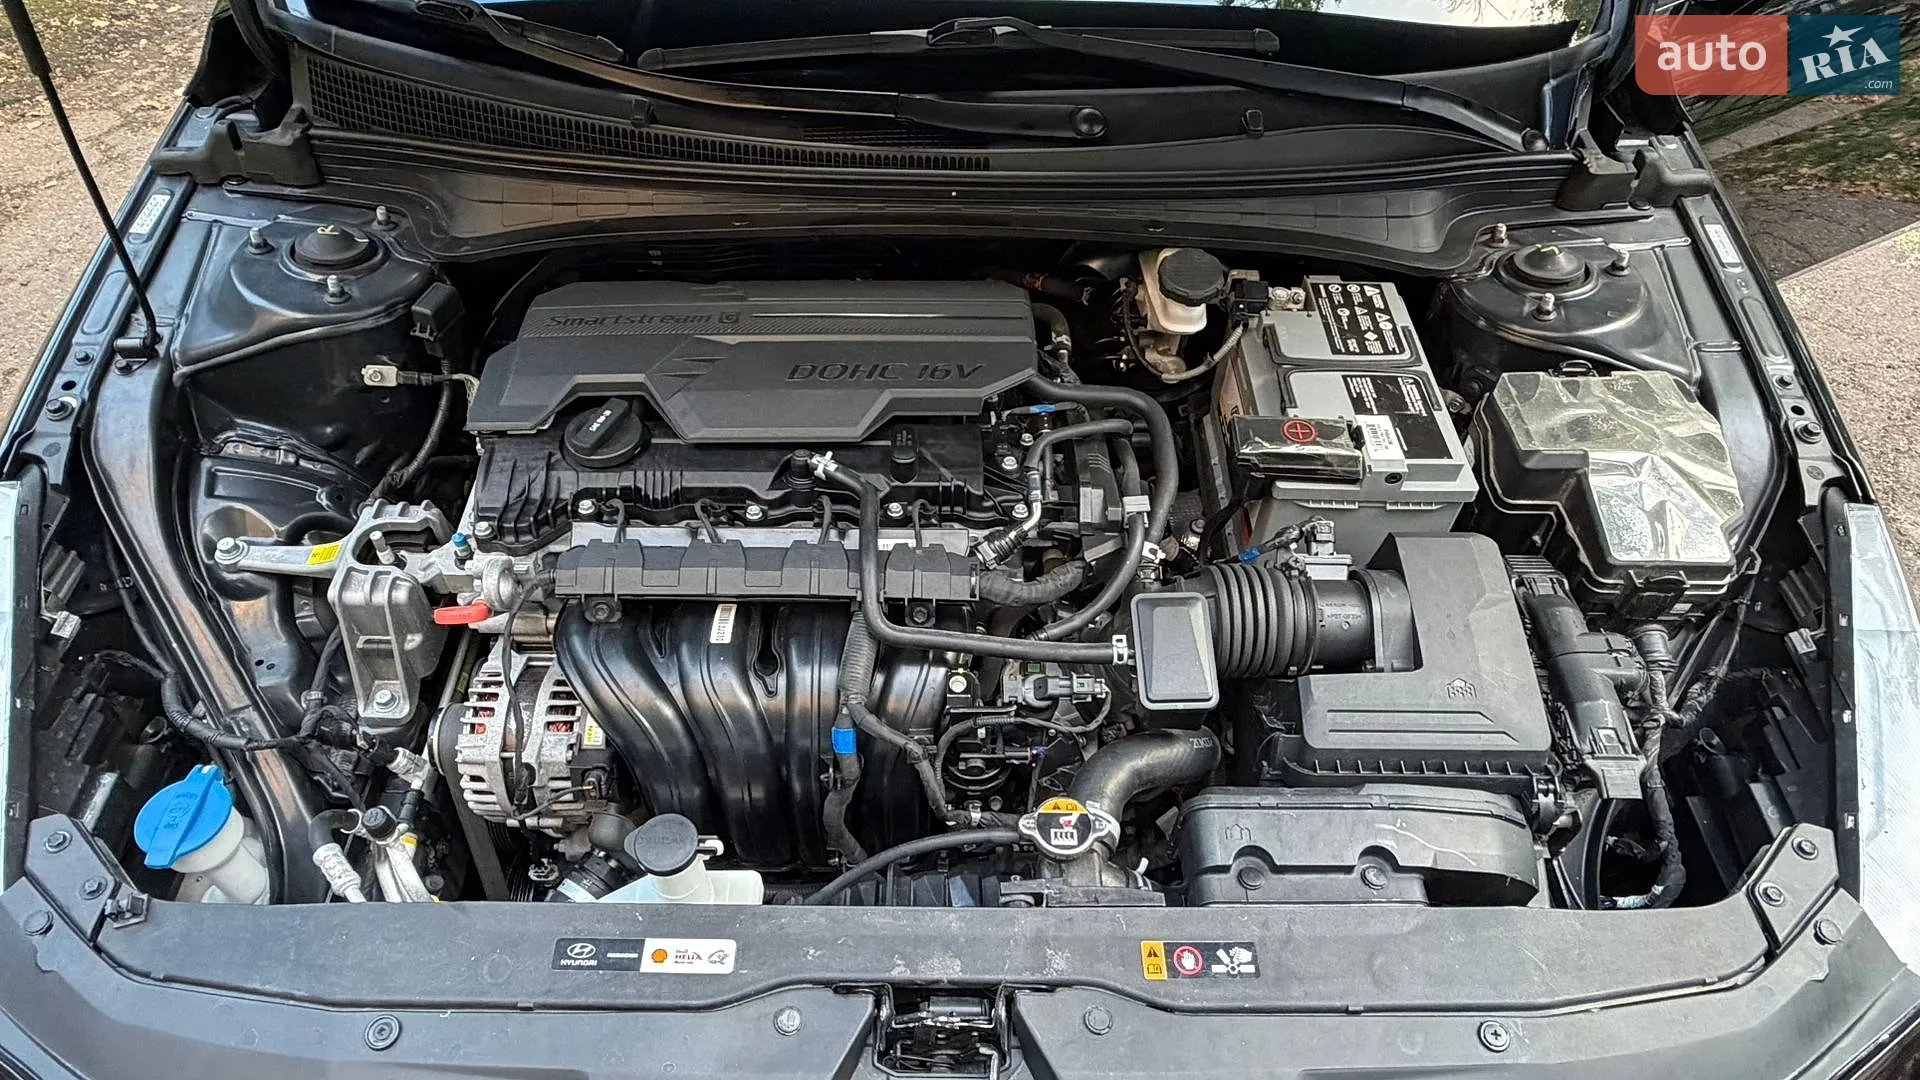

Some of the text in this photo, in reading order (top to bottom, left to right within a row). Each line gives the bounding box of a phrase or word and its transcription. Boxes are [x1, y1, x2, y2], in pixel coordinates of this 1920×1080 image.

[546, 312, 713, 328] Smartstream
[786, 362, 986, 382] DOHC 16V
[560, 958, 598, 967] HYUNDAI
